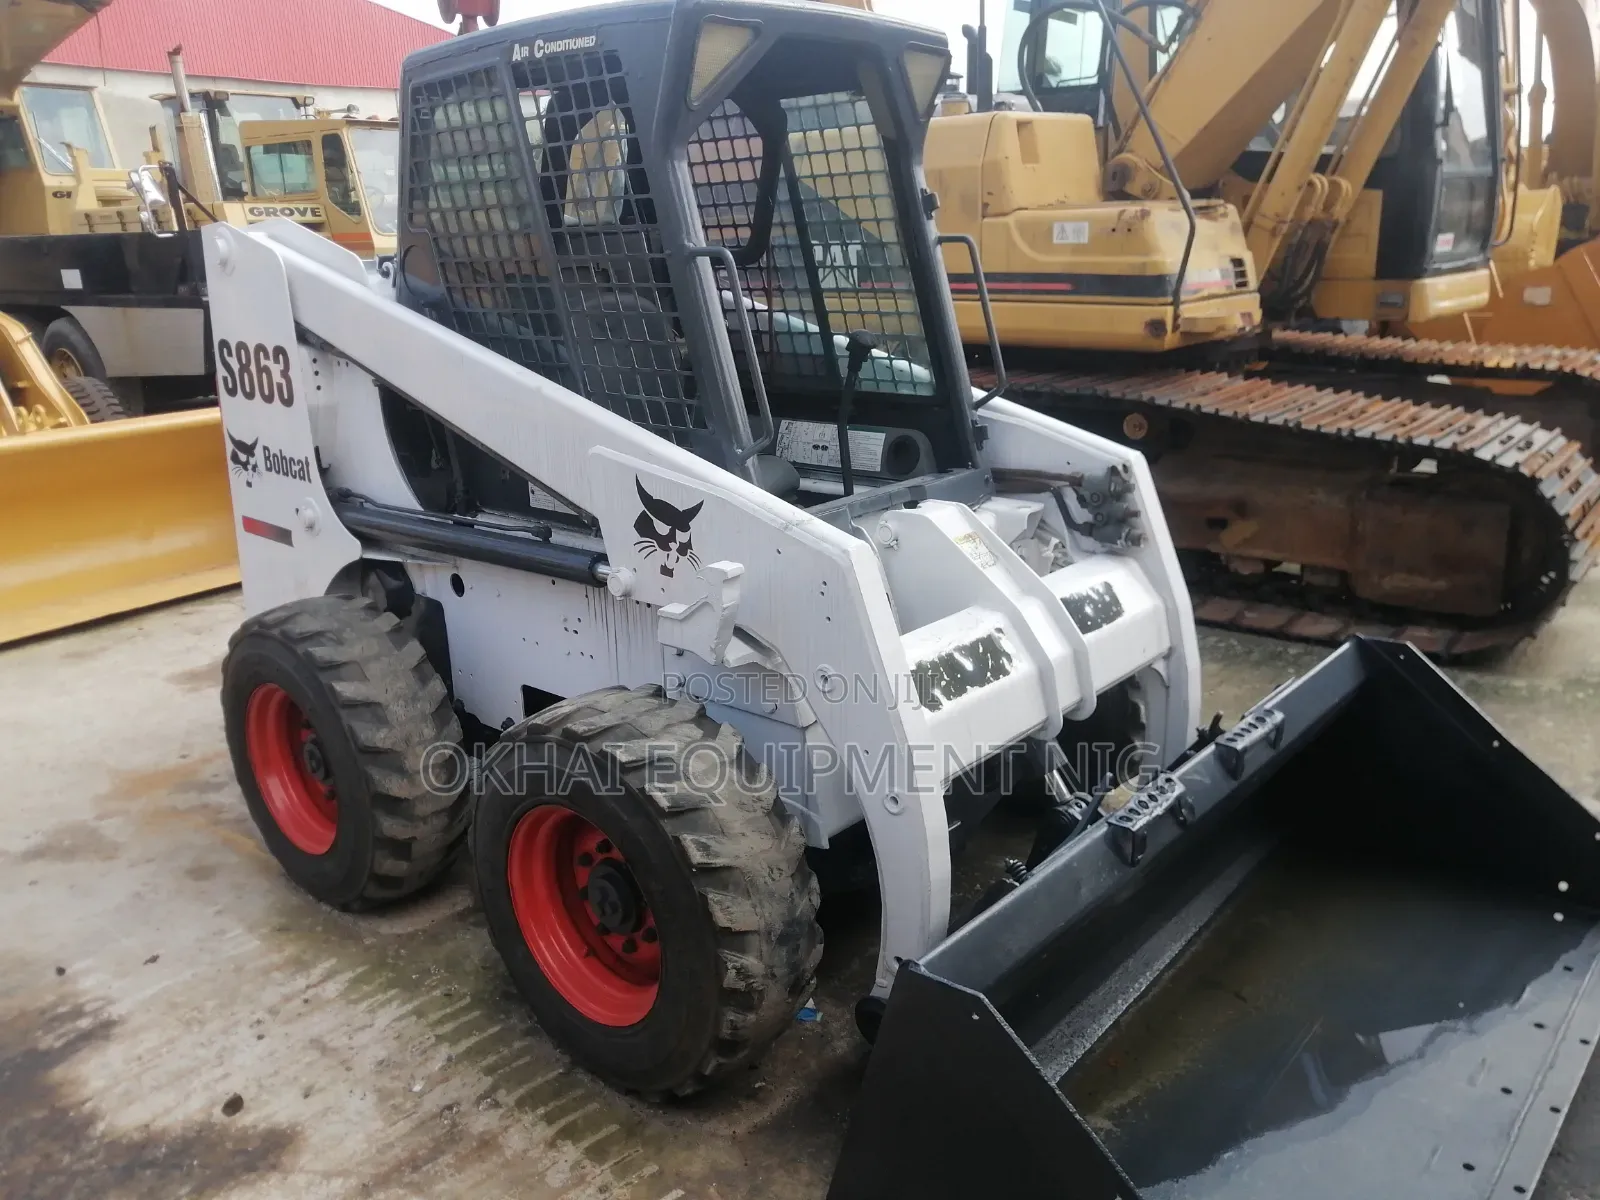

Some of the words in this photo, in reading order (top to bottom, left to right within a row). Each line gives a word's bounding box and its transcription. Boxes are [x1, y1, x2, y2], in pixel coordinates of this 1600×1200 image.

[513, 44, 529, 61] AIR
[534, 36, 596, 58] CONDITIONED
[248, 206, 322, 217] GROVE
[218, 338, 294, 408] S863
[262, 445, 312, 484] Bobcat
